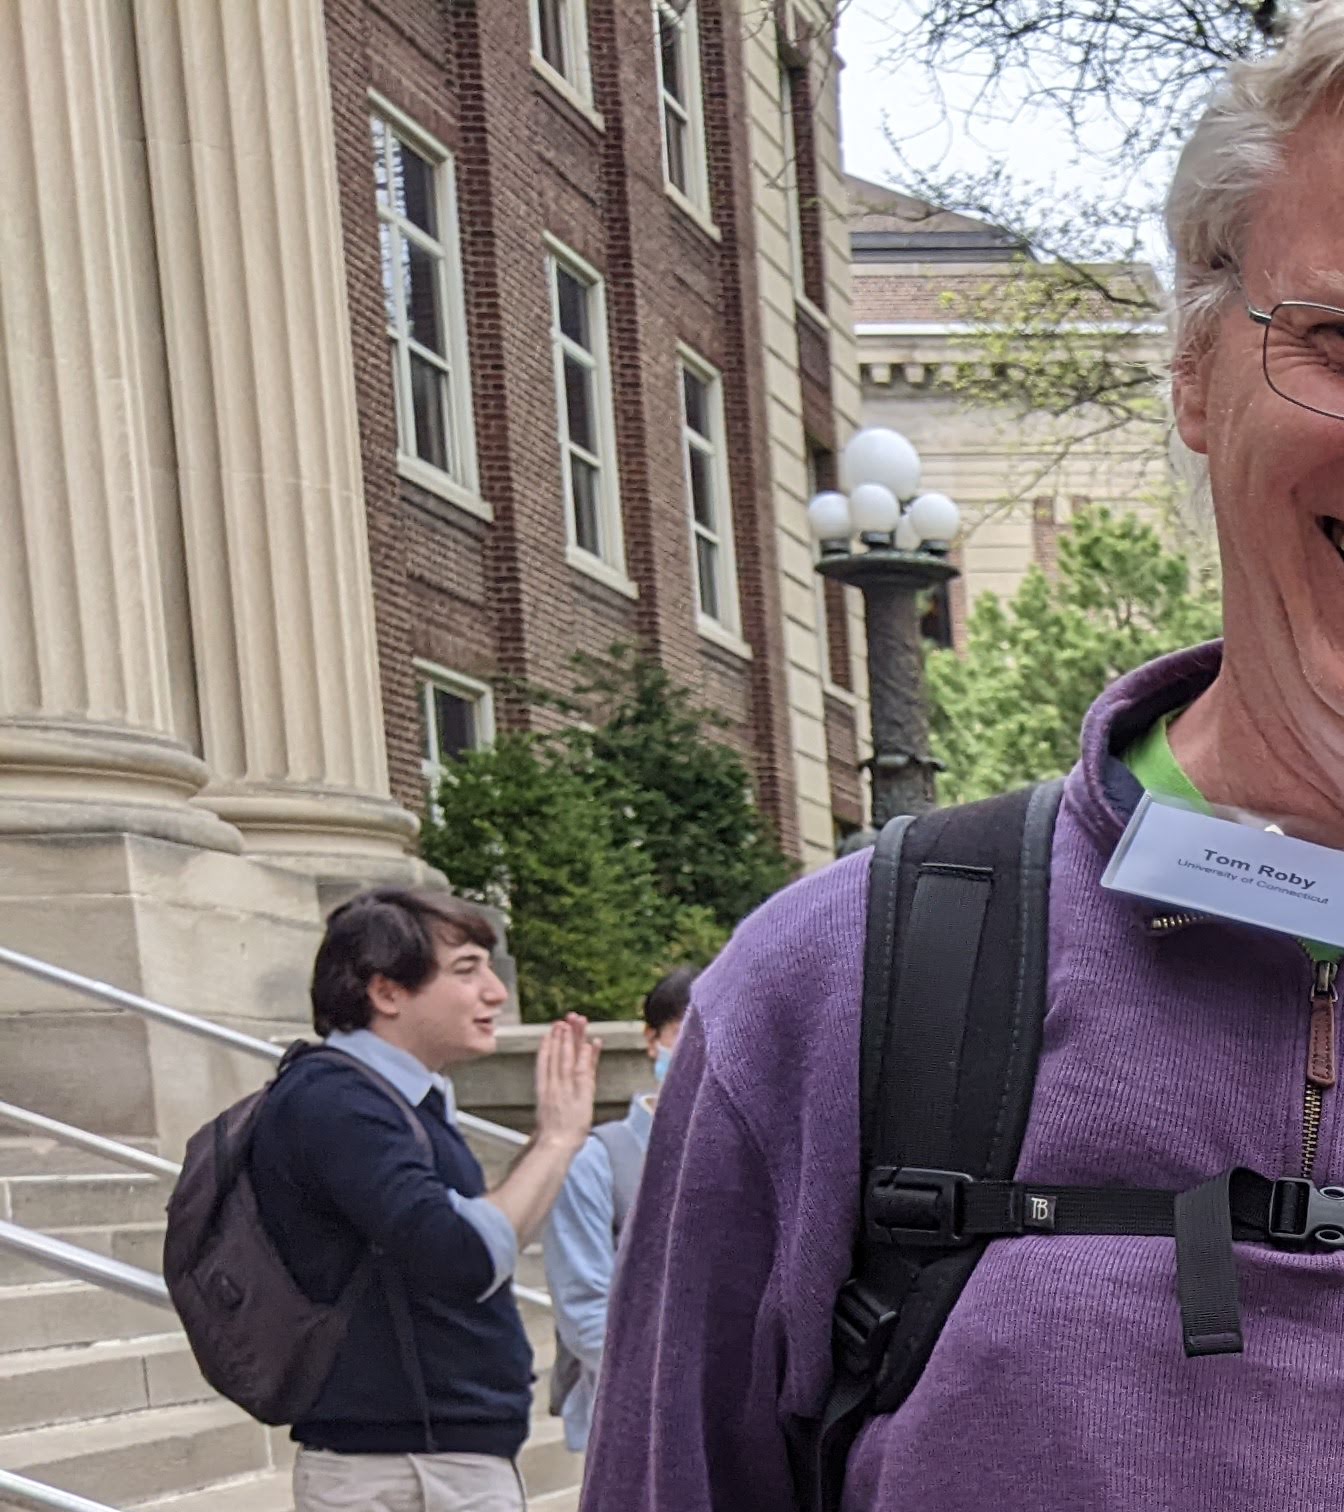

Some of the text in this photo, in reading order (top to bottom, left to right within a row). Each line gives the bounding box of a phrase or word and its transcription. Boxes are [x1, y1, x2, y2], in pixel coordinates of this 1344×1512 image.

[1177, 858, 1238, 881] University
[1256, 880, 1329, 905] Connecticut
[1204, 849, 1316, 889] Tom Roby
